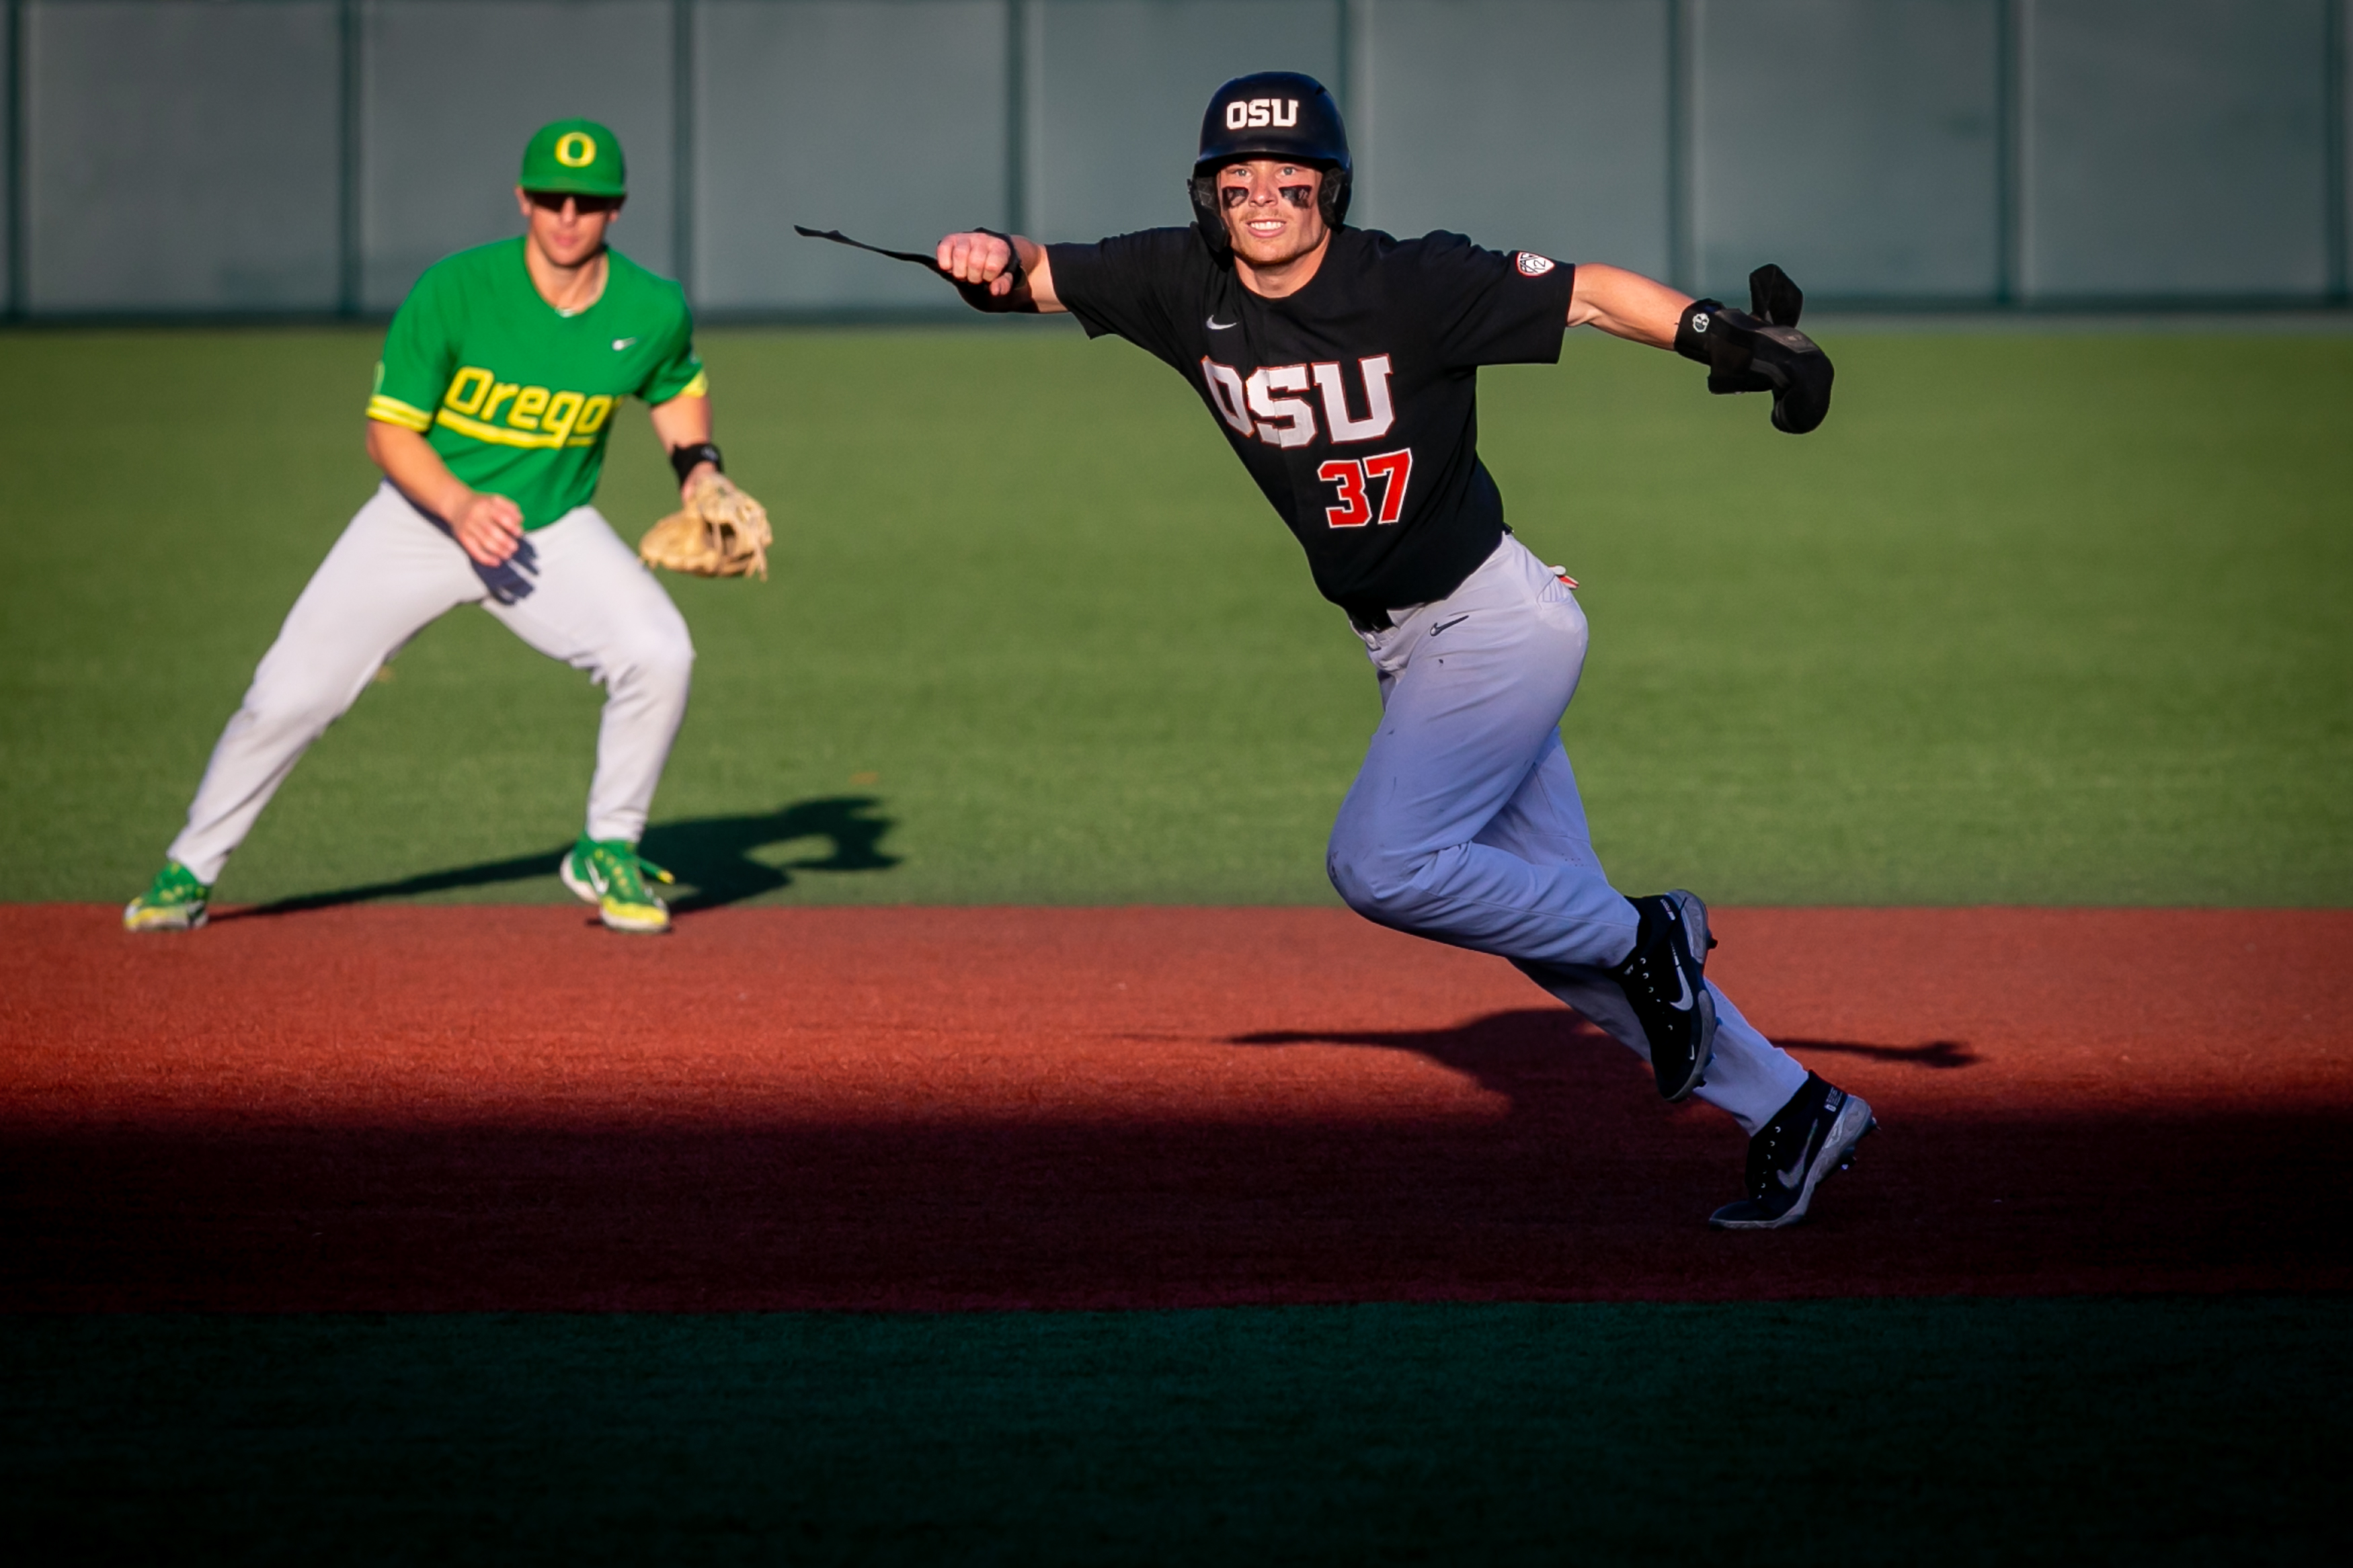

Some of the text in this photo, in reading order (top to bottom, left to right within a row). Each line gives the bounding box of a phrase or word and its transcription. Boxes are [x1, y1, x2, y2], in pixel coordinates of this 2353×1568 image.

[554, 131, 597, 167] O
[1226, 99, 1298, 130] OSU
[444, 365, 624, 450] Orego
[1201, 353, 1396, 450] OSU
[1317, 448, 1412, 528] 37
